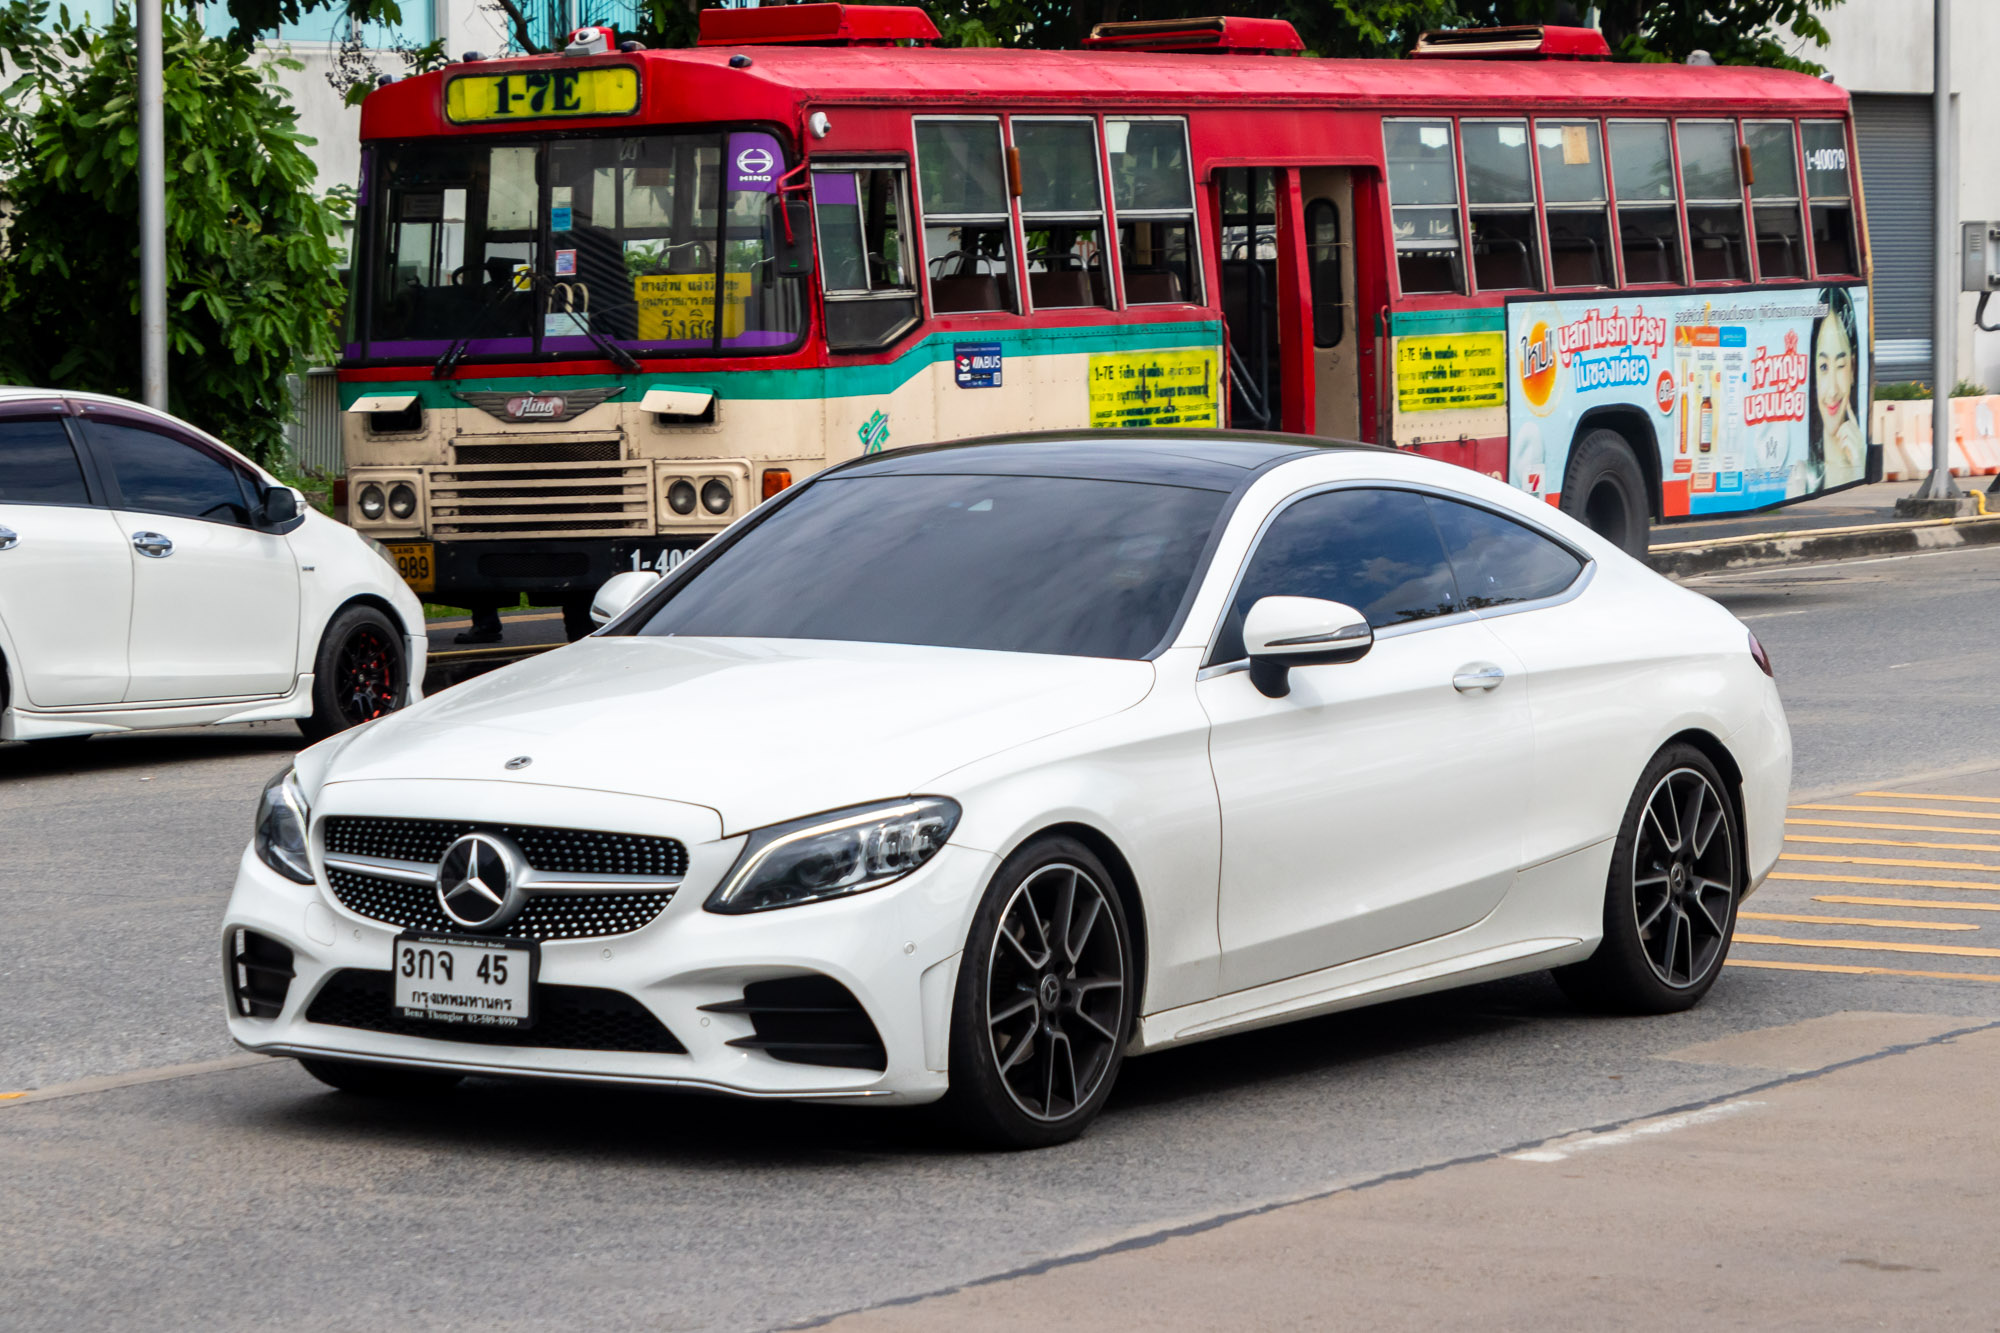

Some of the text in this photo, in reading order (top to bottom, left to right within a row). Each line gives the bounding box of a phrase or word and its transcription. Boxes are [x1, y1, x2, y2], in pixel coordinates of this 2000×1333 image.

[494, 71, 582, 114] 1-7E
[1805, 148, 1846, 170] 1-40079
[1520, 328, 1554, 379] ใหม่!
[1095, 365, 1114, 381] 1-7E
[1573, 345, 1650, 393] ในซองเดียว
[515, 396, 555, 417] Hino
[1744, 382, 1806, 426] นอนน้อย
[398, 556, 429, 578] 989
[630, 548, 696, 577] 1-40
[401, 947, 508, 985] 3กจ 45
[411, 990, 513, 1011] กรุงเทพมหานคร
[404, 1007, 424, 1018] Benz
[427, 1010, 465, 1023] Thonglor
